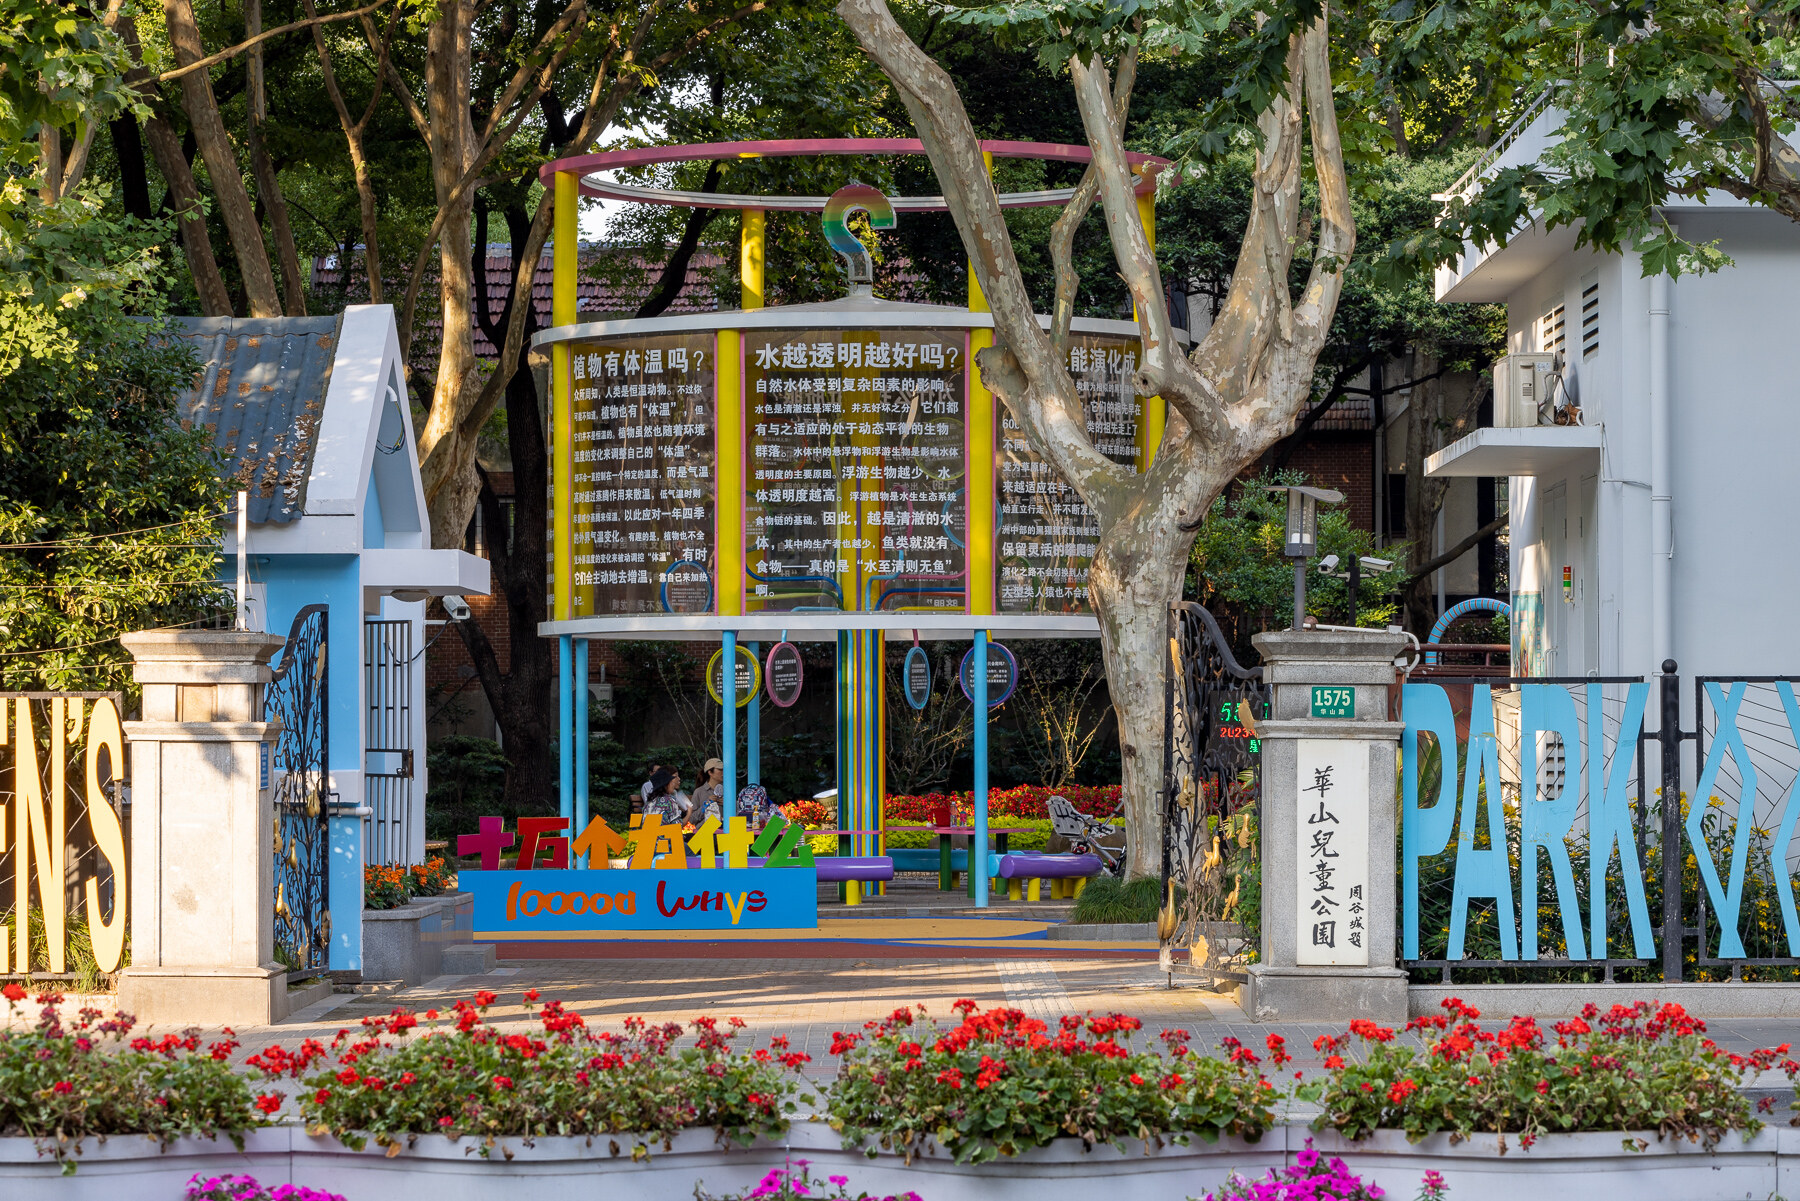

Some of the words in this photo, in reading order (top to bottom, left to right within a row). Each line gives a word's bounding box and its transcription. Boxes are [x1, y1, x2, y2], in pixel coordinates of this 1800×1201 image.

[574, 347, 705, 380] 植物有体温吗？
[755, 342, 959, 370] 水越透明越好吗？
[754, 422, 949, 436] 有与之适应的处于动态平衡的生物
[1315, 690, 1351, 706] 1575
[1402, 682, 1657, 961] PARK
[457, 813, 816, 870] 十万个为什么
